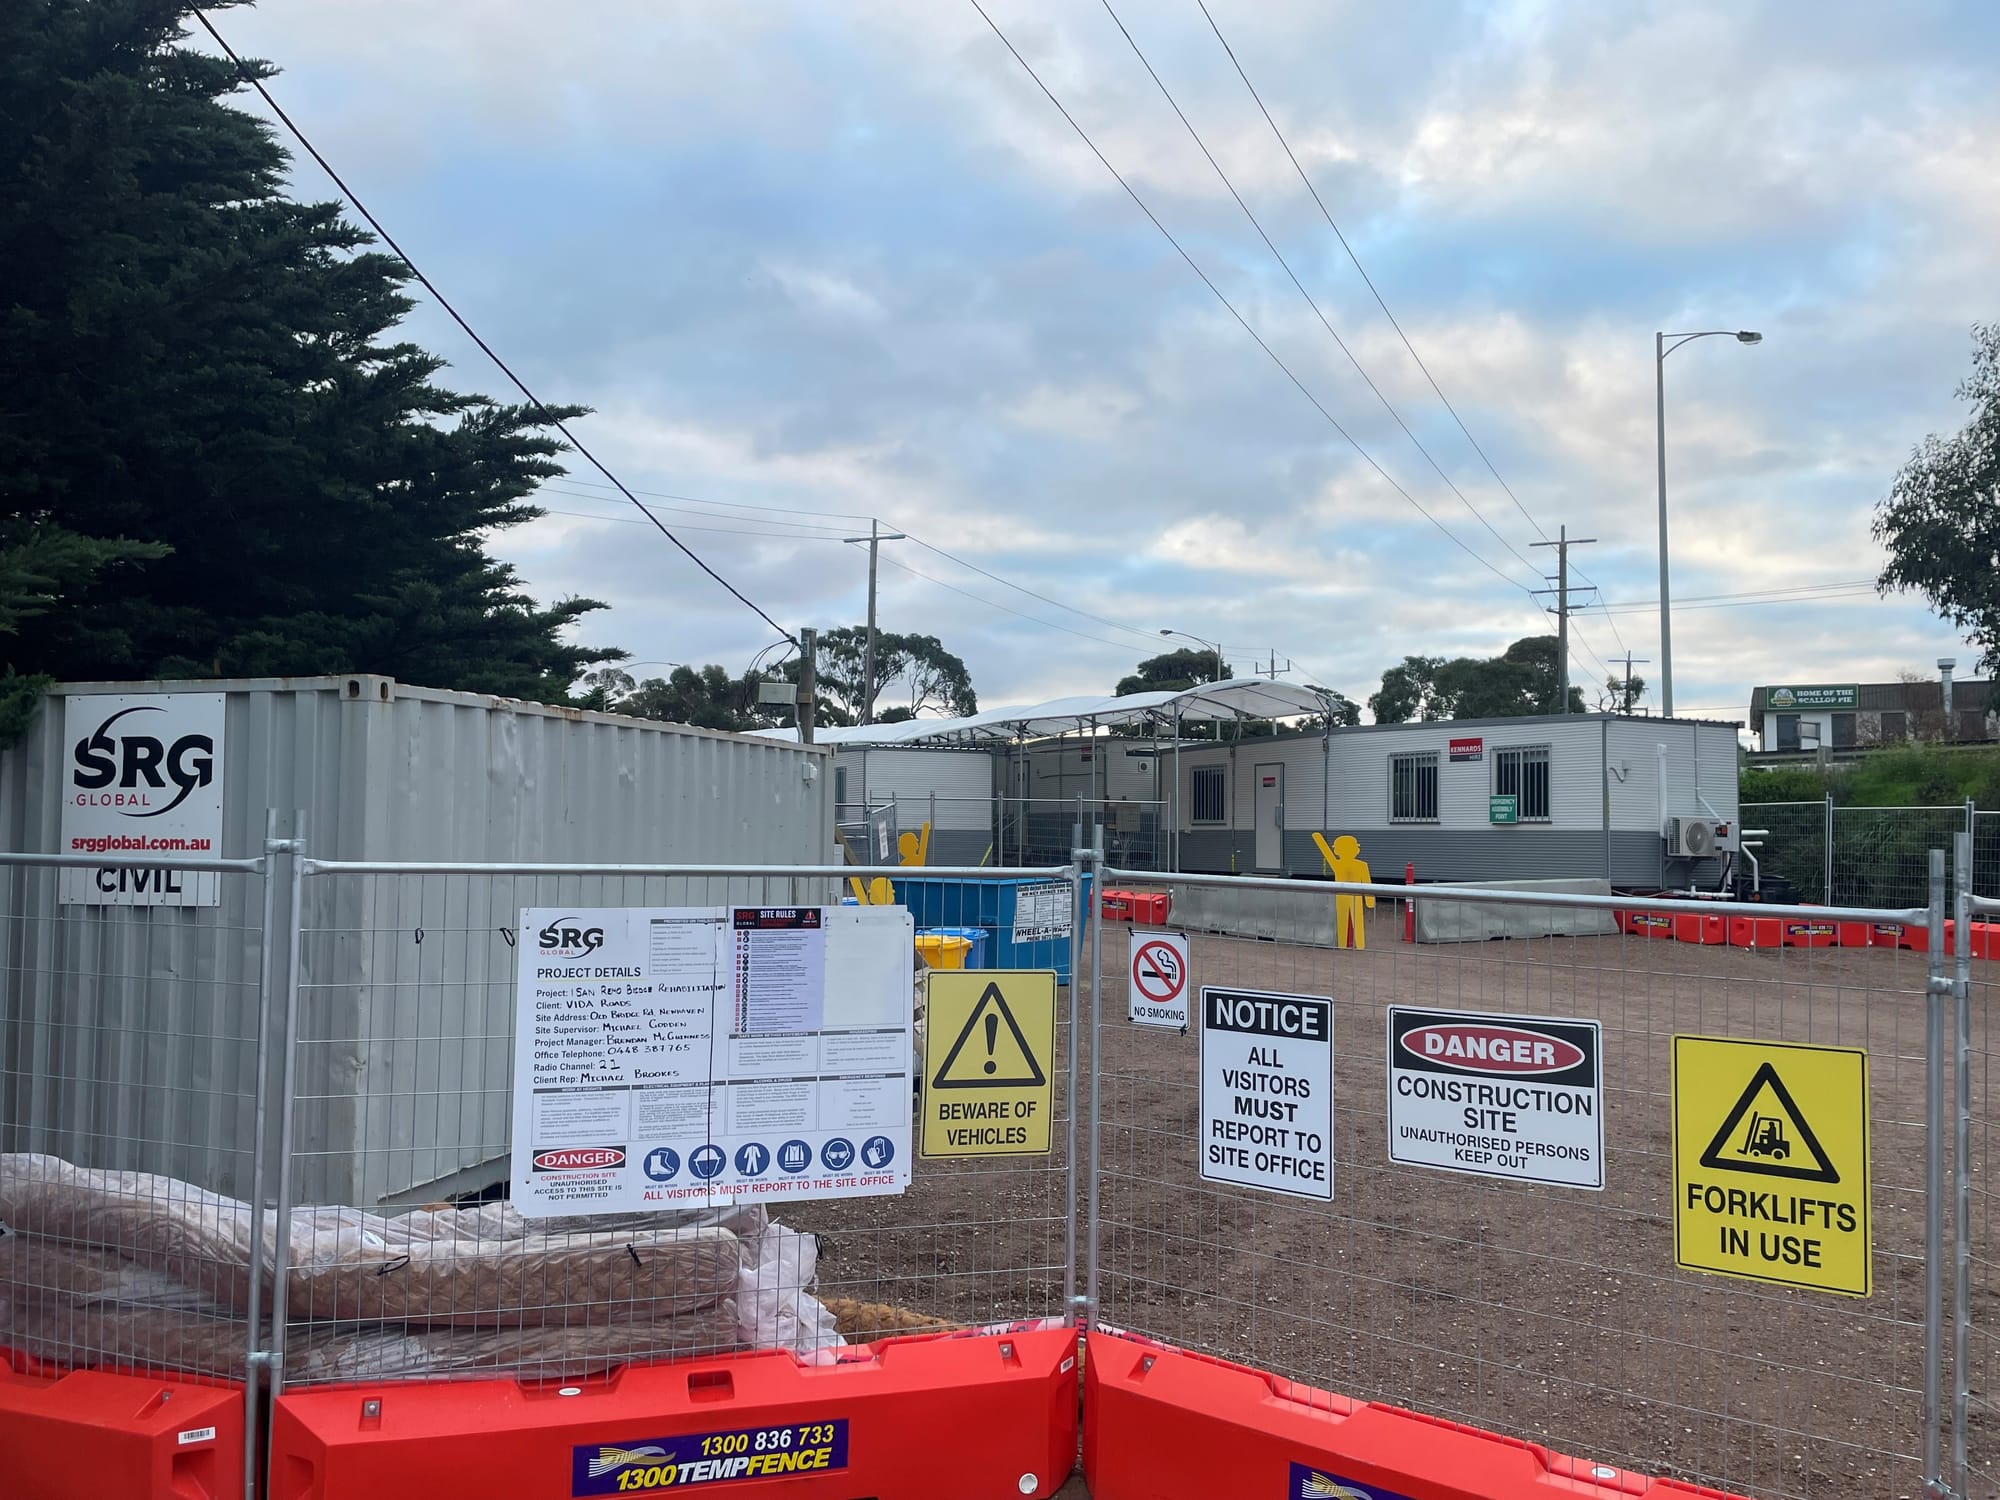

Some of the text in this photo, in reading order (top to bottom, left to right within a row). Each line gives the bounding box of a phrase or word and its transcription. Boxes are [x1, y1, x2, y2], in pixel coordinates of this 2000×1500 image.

[1451, 745, 1481, 753] KENNARDS
[74, 734, 213, 788] SRG
[76, 794, 151, 806] GLOBAL
[72, 834, 210, 852] srgglobal.com.au
[96, 868, 182, 893] CIVIL
[760, 911, 775, 919] SITE
[539, 928, 604, 948] SRG
[537, 967, 641, 978] PROJECT DETAILS
[537, 989, 568, 998] Project:
[576, 988, 595, 997] SAN
[567, 1000, 594, 1008] VIDA
[1134, 1006, 1185, 1021] NO SMOKING
[536, 1014, 551, 1022] Site
[1215, 998, 1319, 1035] NOTICE
[554, 1026, 599, 1035] Supervisor:
[535, 1038, 605, 1047] Project Manager:
[608, 1046, 638, 1055] 0448
[1425, 1032, 1555, 1066] DANGER
[534, 1050, 606, 1059] Office Telephone:
[1248, 1047, 1283, 1068] ALL
[560, 1062, 595, 1070] Channel:
[534, 1075, 578, 1084] Client Rep:
[1222, 1069, 1310, 1098] VISITORS
[1397, 1076, 1592, 1116] CONSTRUCTION
[939, 1101, 1036, 1120] BEWARE OF
[1234, 1097, 1298, 1122] MUST
[1463, 1108, 1517, 1133] SITE
[947, 1127, 1027, 1146] VEHICLES
[1213, 1119, 1321, 1153] REPORT TO
[1400, 1126, 1590, 1161] UNAUTHORISED PERSONS
[545, 1152, 615, 1165] DANGER
[1209, 1144, 1325, 1181] SITE OFFICE
[1455, 1148, 1528, 1169] KEEP OUT
[541, 1173, 599, 1181] CONSTRUCTION
[551, 1179, 607, 1187] UNAUTHORISED
[644, 1176, 894, 1200] ALL VISITORS MUST REPORT TO THE SITE OFFICE
[1687, 1183, 1857, 1233] FORKLIFTS
[1720, 1227, 1821, 1268] IN USE
[701, 1424, 834, 1456] 1300 836 733
[616, 1446, 832, 1491] 1300TEMPFENCE
